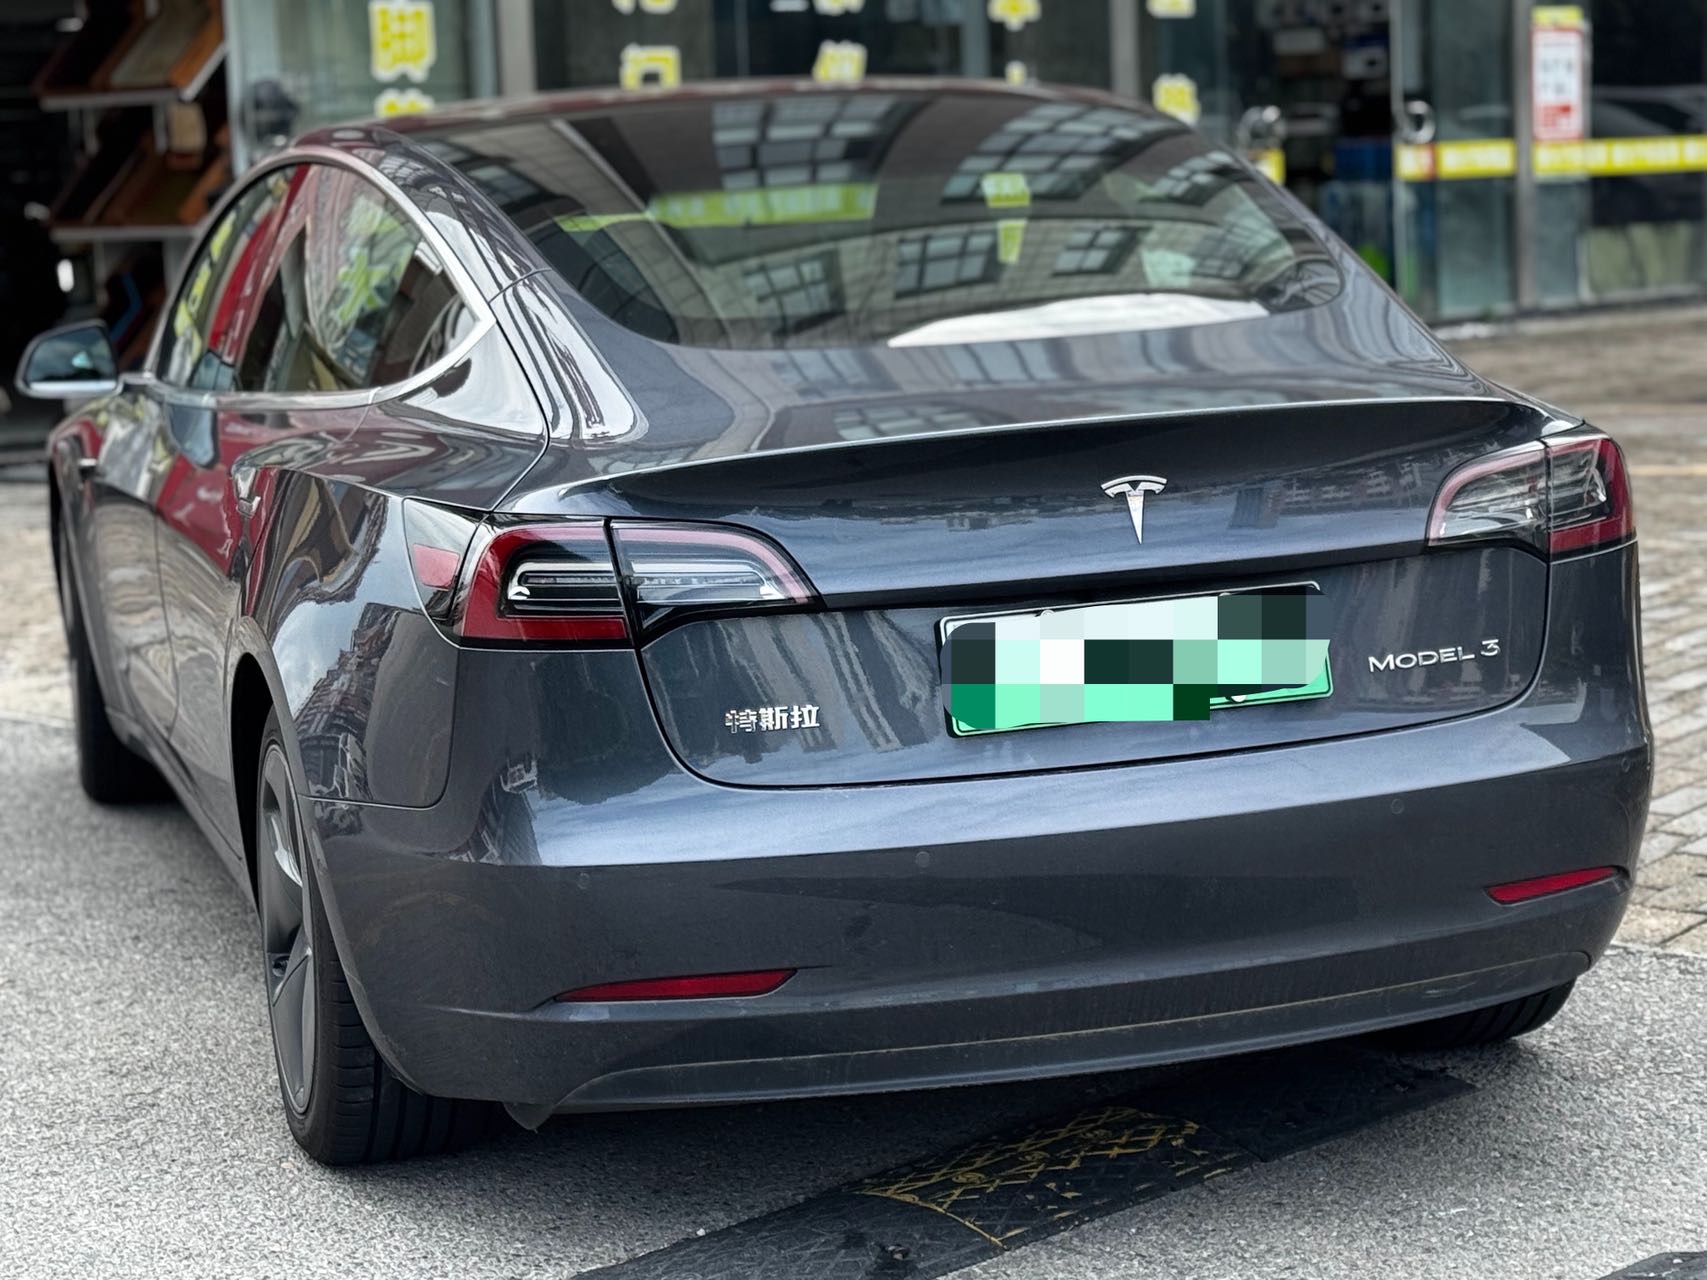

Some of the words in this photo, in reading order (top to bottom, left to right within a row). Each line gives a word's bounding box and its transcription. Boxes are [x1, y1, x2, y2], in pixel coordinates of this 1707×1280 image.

[1367, 645, 1476, 673] MODEL
[1480, 638, 1501, 657] 3
[724, 704, 821, 734] 特斯拉
